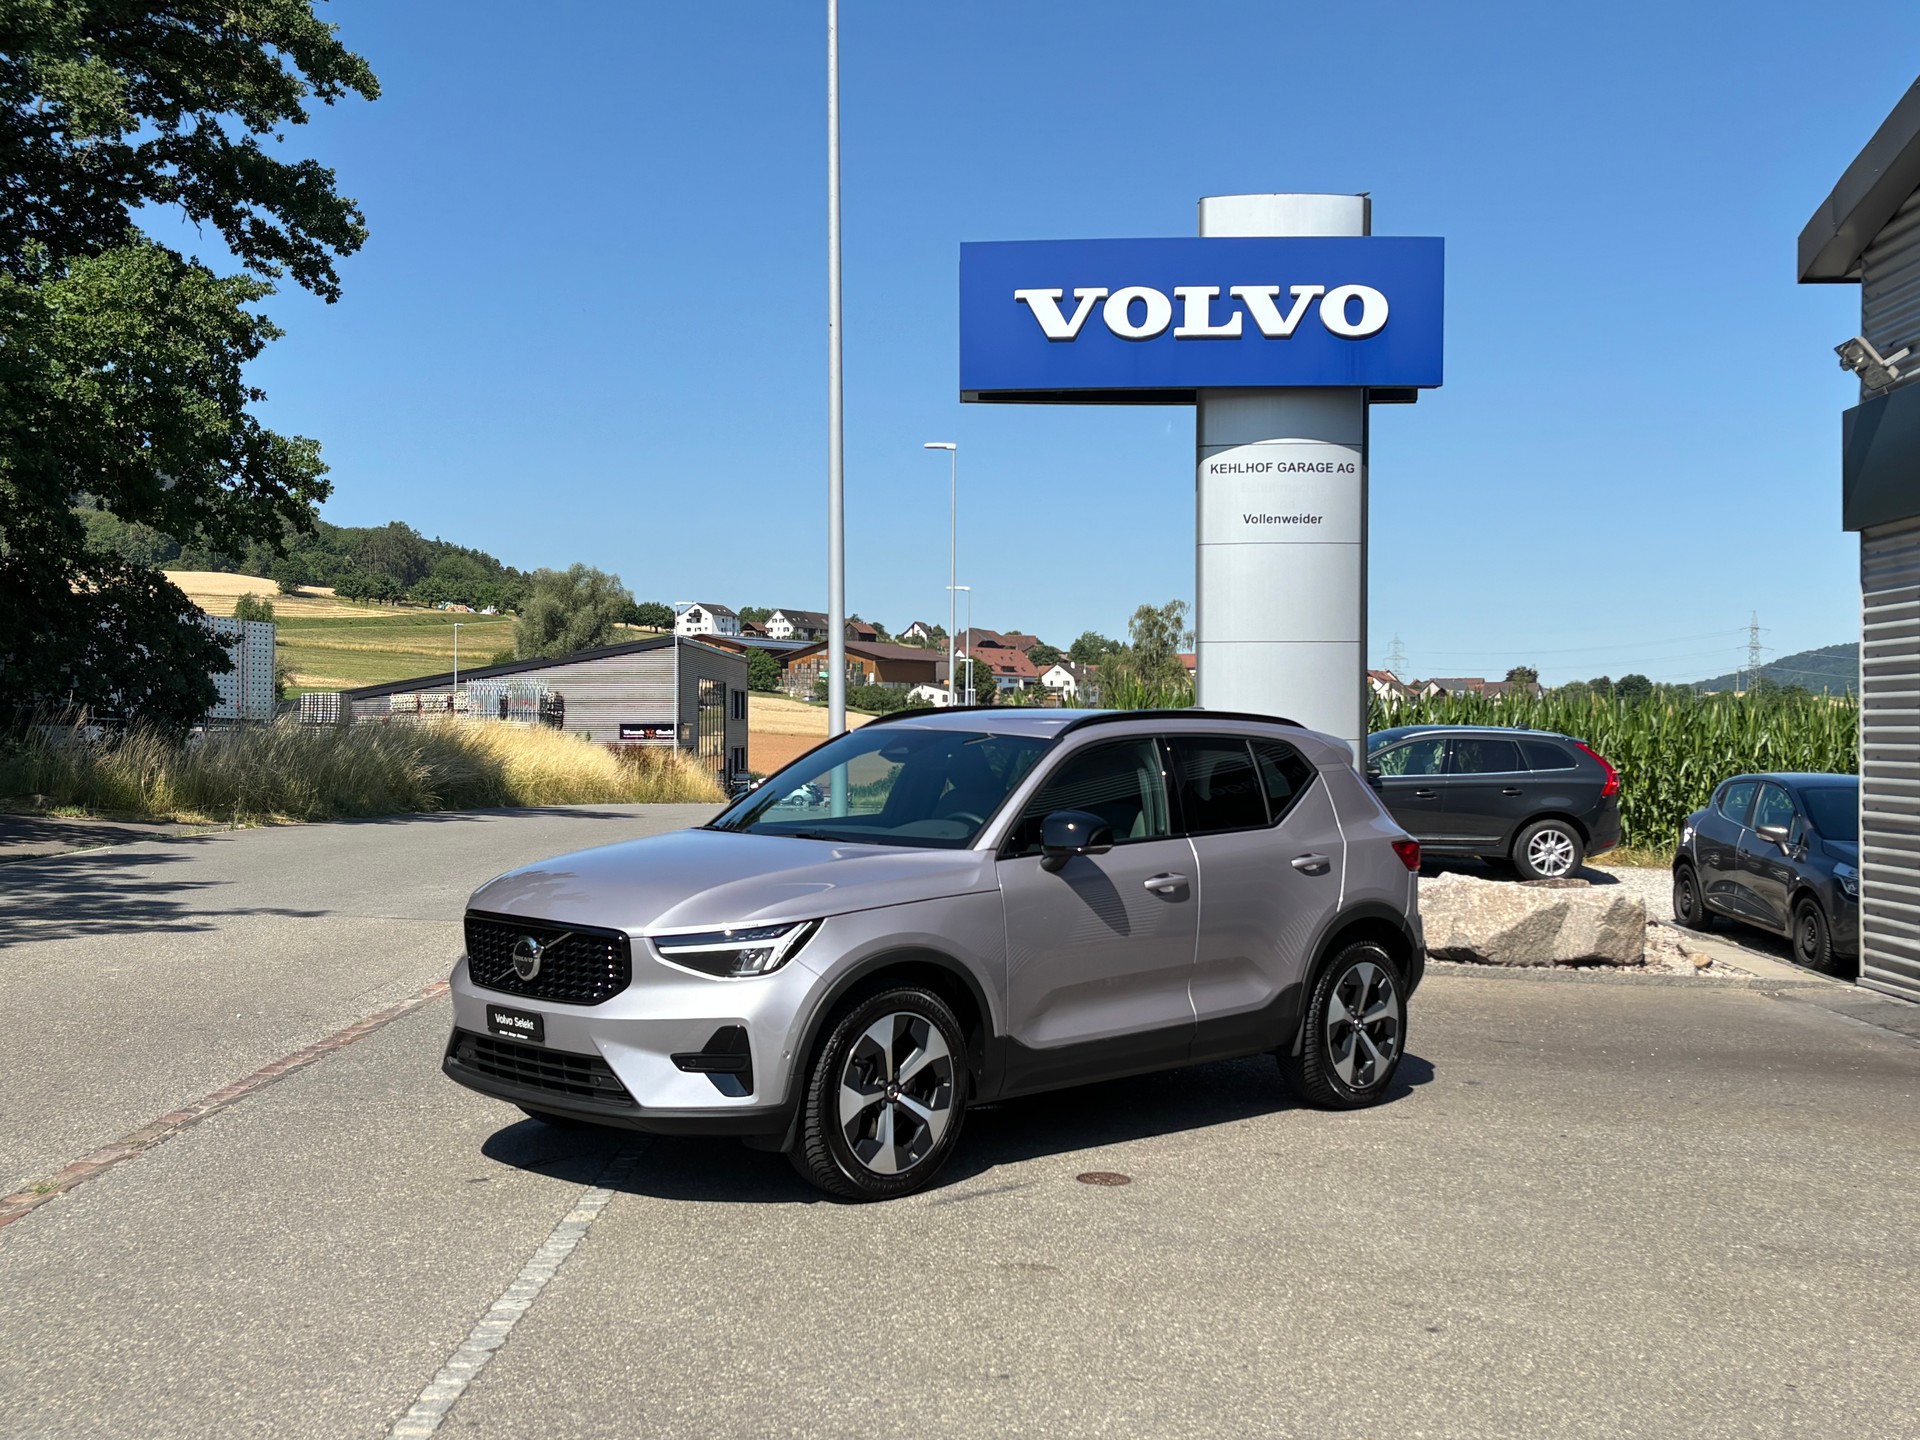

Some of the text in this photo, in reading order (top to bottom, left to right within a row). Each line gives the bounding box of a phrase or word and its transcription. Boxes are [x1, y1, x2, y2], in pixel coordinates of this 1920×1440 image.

[1014, 284, 1390, 341] VOLVO
[1210, 462, 1355, 474] KEHLHOF GARAGE AG
[1243, 513, 1324, 525] Vollenweider
[494, 1013, 535, 1030] Volvo Selekt
